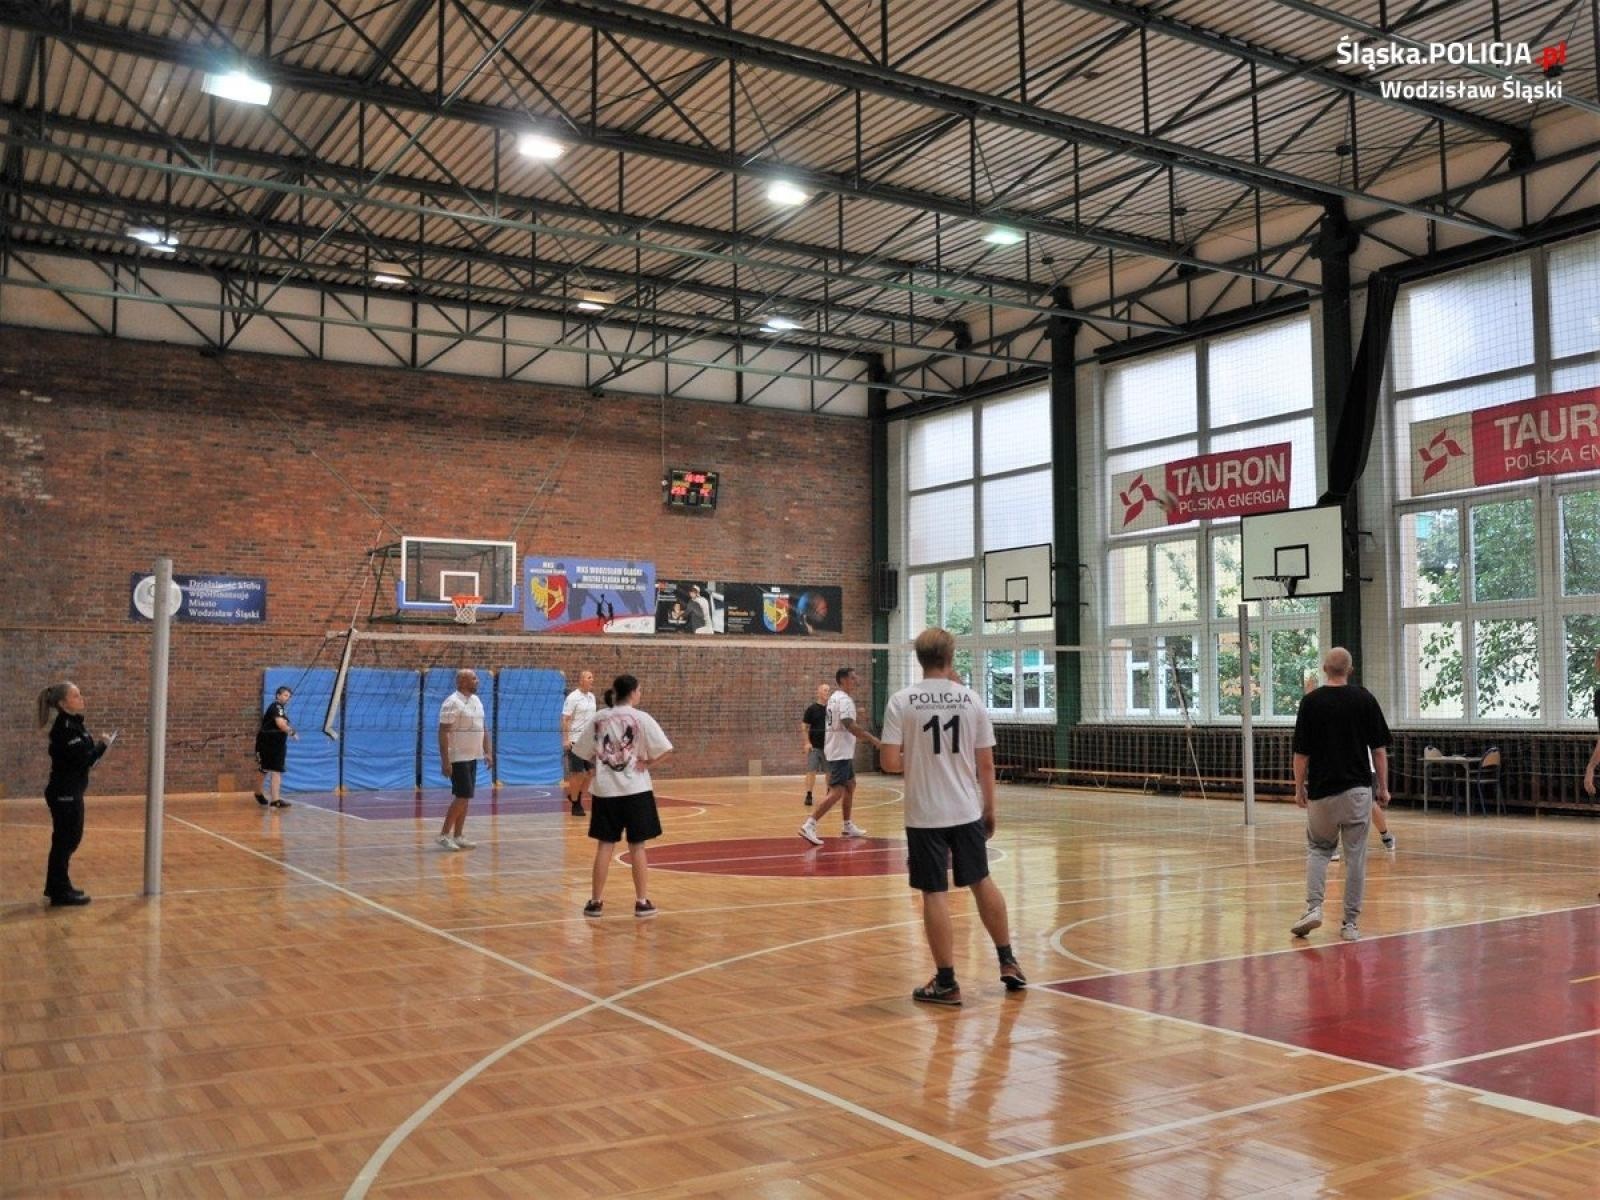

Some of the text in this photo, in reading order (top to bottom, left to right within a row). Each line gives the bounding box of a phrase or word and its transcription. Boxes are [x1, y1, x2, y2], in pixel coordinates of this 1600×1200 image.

[1505, 449, 1573, 472] POLSKA
[1171, 452, 1286, 497] TAURON
[1228, 488, 1286, 507] ENERGIA
[188, 599, 217, 608] Miasto
[188, 607, 260, 619] Wodzisław Śląski
[909, 692, 973, 705] POLICJA
[922, 714, 961, 755] 11
